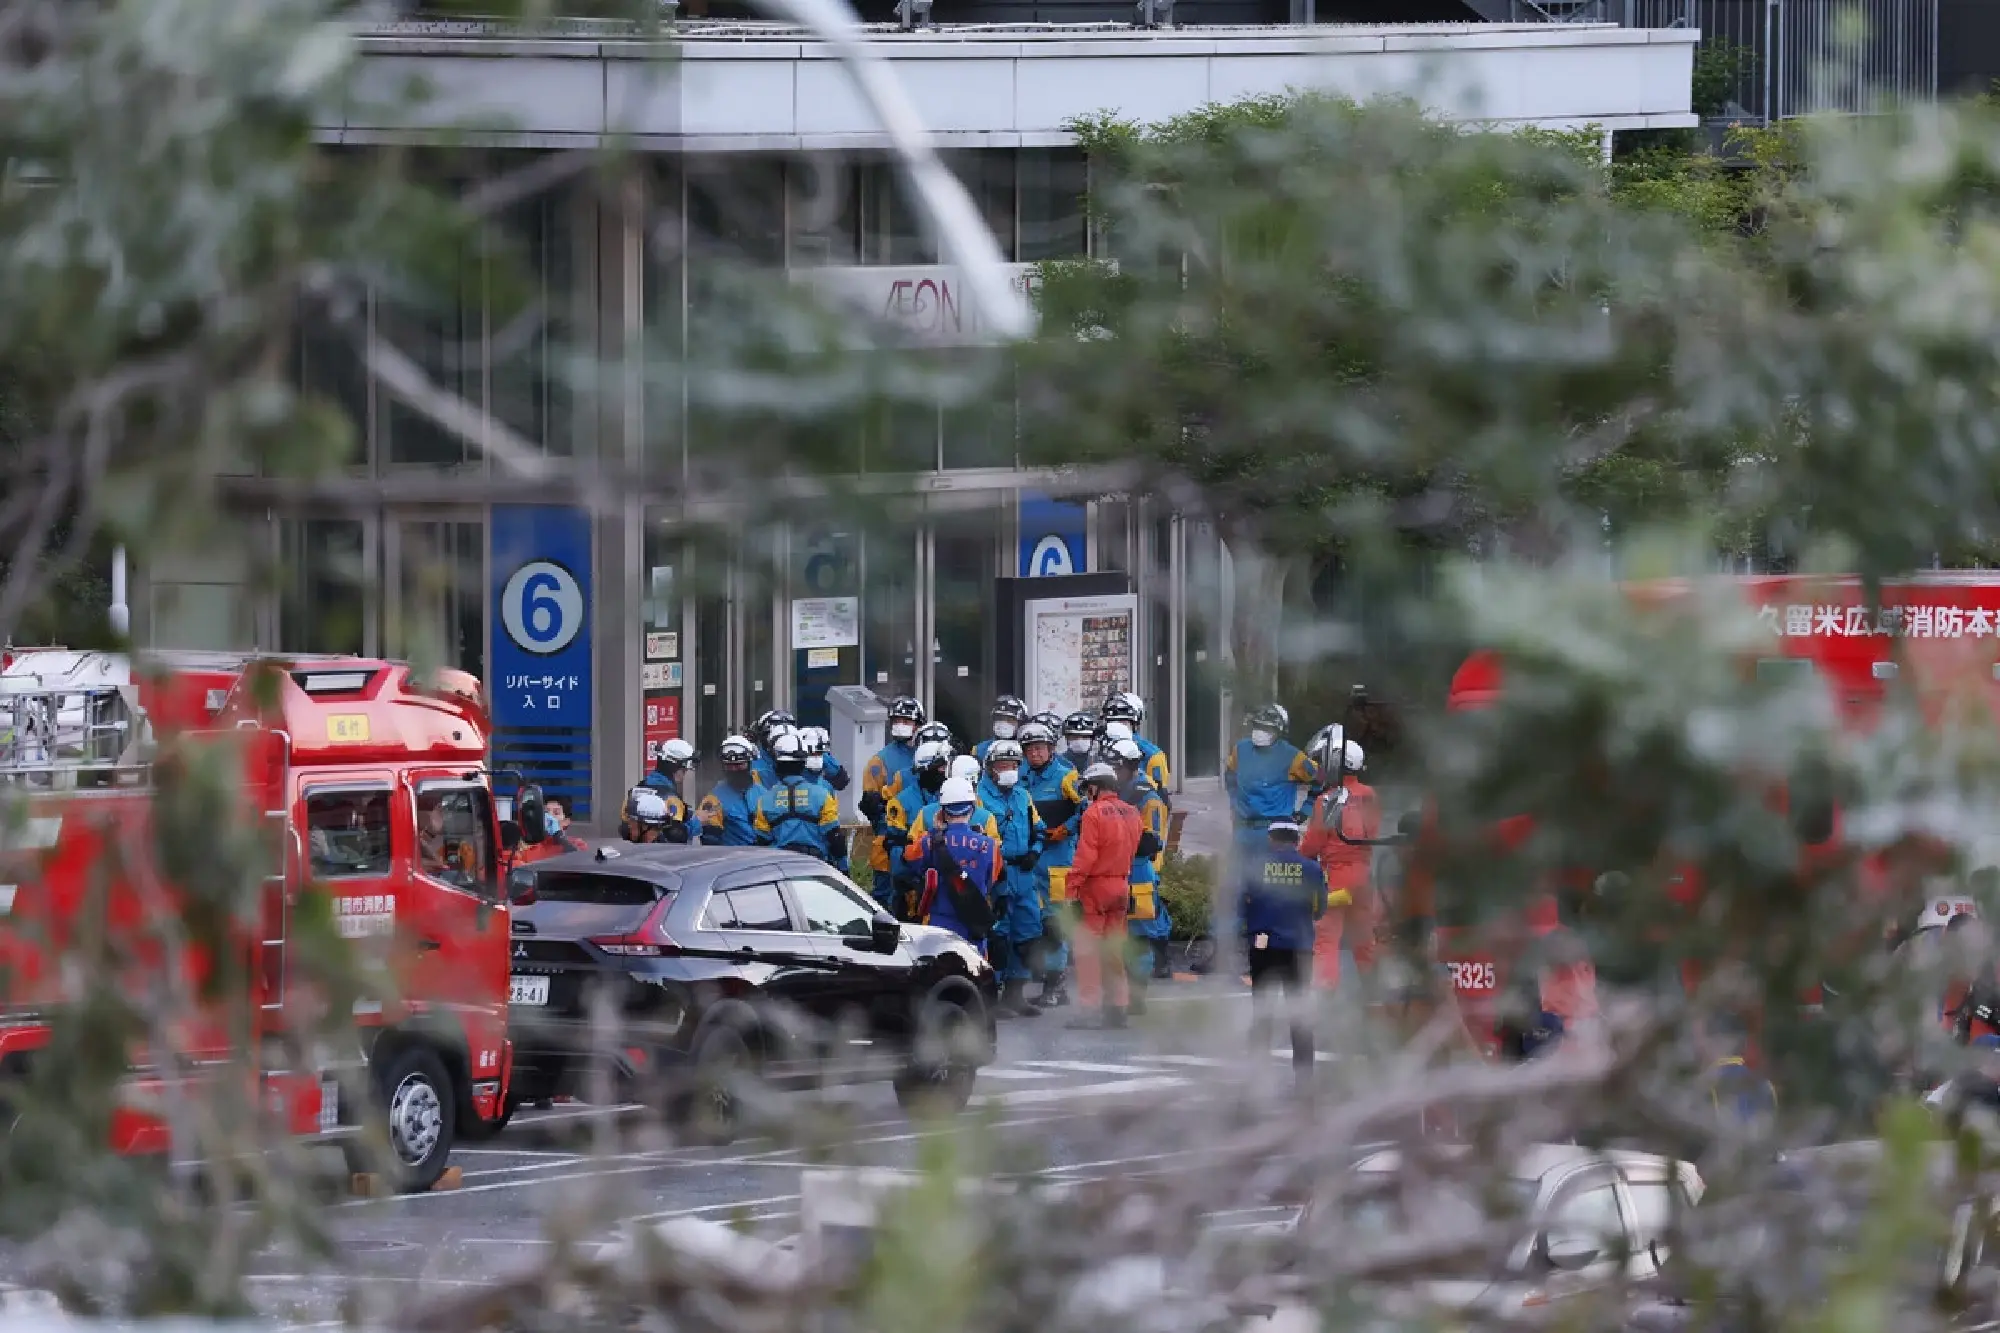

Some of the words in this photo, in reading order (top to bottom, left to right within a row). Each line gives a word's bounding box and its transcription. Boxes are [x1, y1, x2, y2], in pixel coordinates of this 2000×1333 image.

[522, 573, 562, 642] 6
[1757, 604, 2000, 637] 久留米広域消防本
[506, 675, 579, 691] リバーサイド
[523, 695, 560, 709] 入口
[926, 834, 989, 854] LICE
[1264, 862, 1303, 877] POLICE
